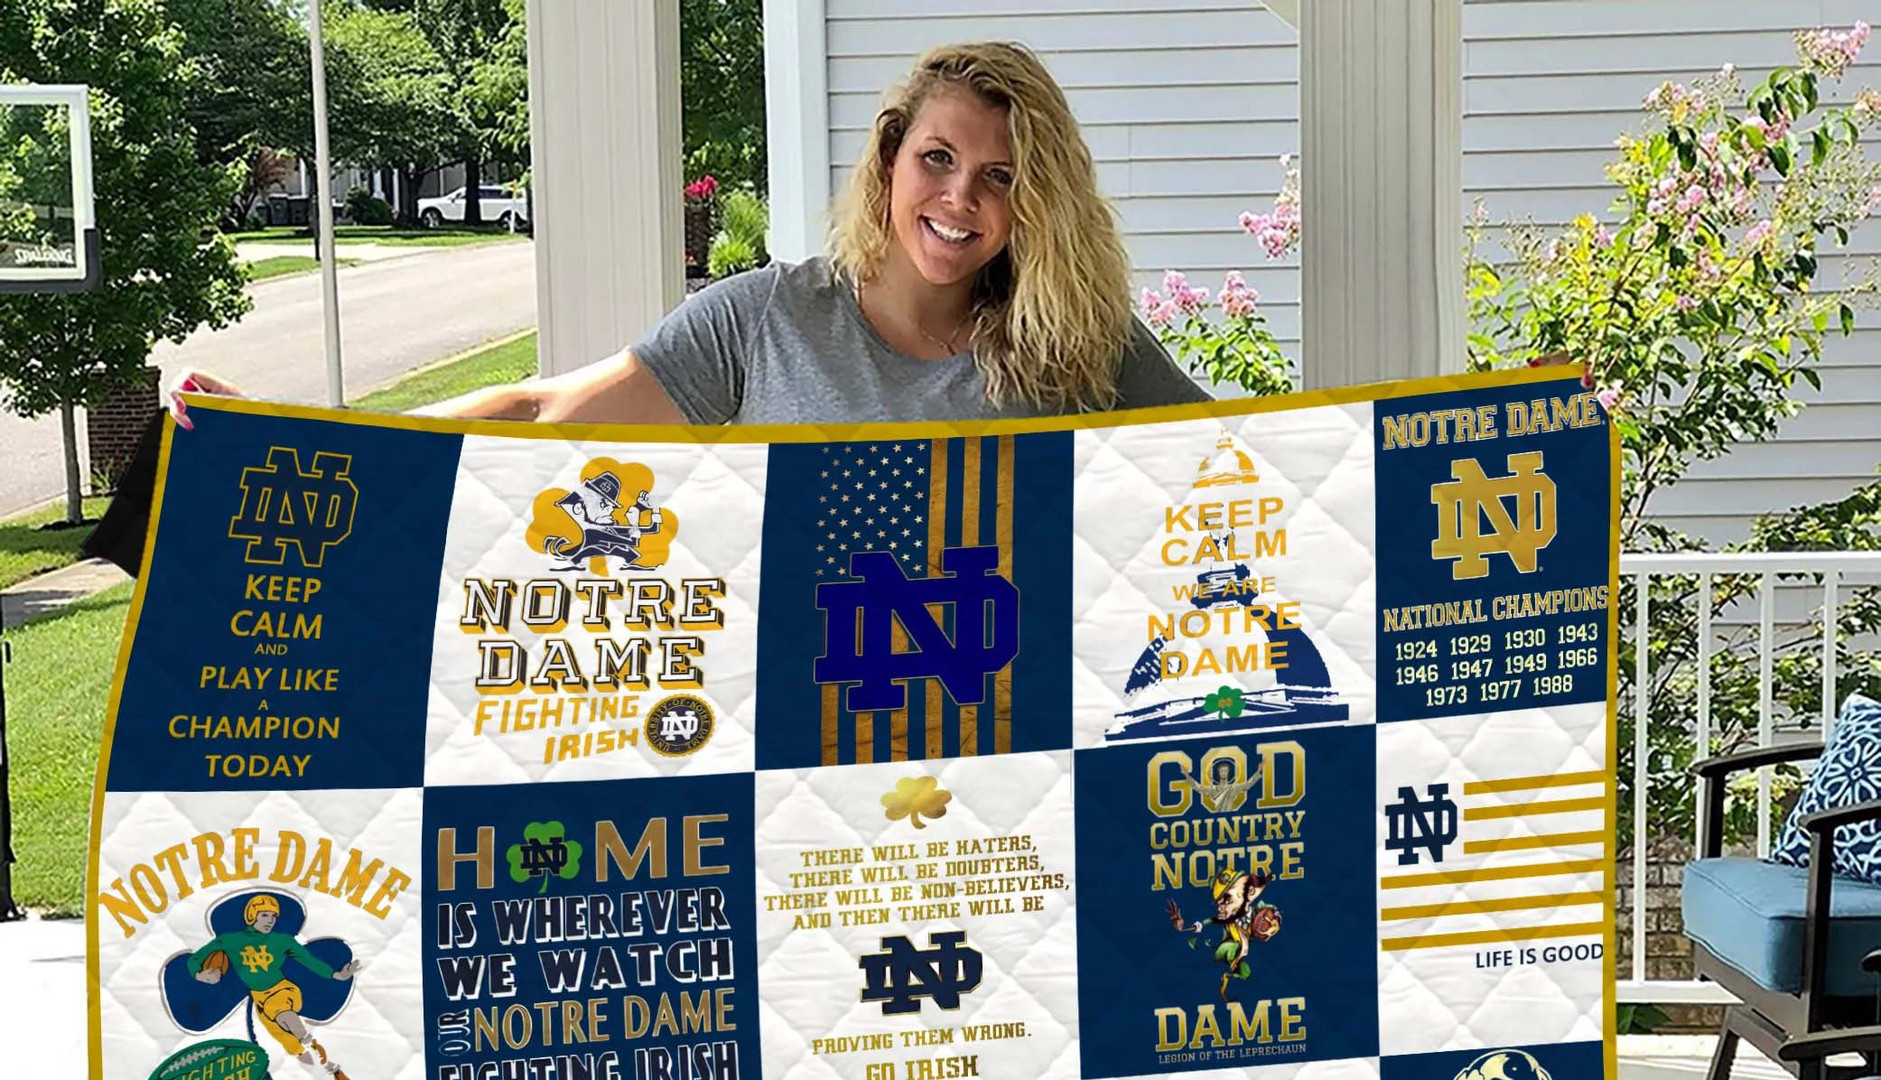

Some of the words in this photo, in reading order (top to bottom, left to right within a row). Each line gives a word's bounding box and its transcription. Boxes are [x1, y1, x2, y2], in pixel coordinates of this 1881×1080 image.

[14, 247, 74, 264] SPALDING
[1382, 404, 1498, 450] NOTRE
[1165, 497, 1284, 533] KEEP
[1161, 529, 1287, 567] CALM
[245, 574, 322, 603] KEEP
[460, 577, 727, 634] NOTRE
[1172, 583, 1213, 601] WE
[1223, 576, 1276, 597] ARE
[230, 610, 323, 639] CALM
[1147, 601, 1302, 642] NOTRE
[1383, 599, 1488, 632] NATIONAL
[1493, 585, 1610, 621] CHAMPIONS
[254, 643, 288, 656] AND
[1160, 641, 1290, 680] DAME
[1395, 640, 1438, 661] 1924
[1450, 634, 1491, 655] 1929
[1504, 628, 1546, 650] 1930
[1557, 622, 1598, 645] 1943
[200, 666, 273, 690] PLAY
[279, 668, 339, 691] LIKE
[475, 636, 705, 695] DAME
[1395, 664, 1438, 685] 1946
[1451, 659, 1492, 680] 1947
[1505, 653, 1547, 675] 1949
[1557, 647, 1598, 669] 1966
[257, 699, 268, 711] A
[1426, 685, 1468, 707] 1973
[1480, 680, 1521, 702] 1977
[1533, 674, 1573, 697] 1988
[168, 715, 340, 739] CHAMPION
[473, 695, 639, 737] FIGHTING
[544, 727, 638, 765] IRISH
[205, 754, 311, 778] TODAY
[1147, 740, 1305, 817] GOD
[1150, 810, 1305, 850] COUNTRY
[800, 847, 864, 867] THERE
[871, 843, 919, 864] WILL
[926, 841, 949, 857] BE
[956, 835, 1037, 855] HATERS,
[1151, 841, 1305, 891] NOTRE
[99, 827, 260, 939] NOTRE
[268, 830, 412, 921] DAME
[790, 869, 852, 888] THERE
[861, 865, 908, 885] WILL
[916, 862, 938, 879] BE
[946, 855, 1045, 877] DOUBTERS,
[764, 893, 828, 912] THERE
[835, 888, 883, 907] WILL
[891, 885, 913, 902] BE
[921, 874, 1070, 900] NON-BELIEVERS,
[437, 902, 477, 949] IS
[492, 886, 732, 945] WHEREVER
[793, 913, 831, 930] AND
[839, 908, 890, 927] THEN
[898, 902, 961, 922] THERE
[968, 898, 1015, 916] WILL
[1023, 896, 1044, 912] BE
[436, 953, 517, 1001] WE
[538, 937, 734, 993] WATCH
[1476, 950, 1513, 969] LIFE
[1520, 947, 1537, 966] IS
[1542, 943, 1604, 963] GOOD
[474, 997, 610, 1052] NOTRE
[623, 987, 737, 1040] DAME
[811, 1033, 893, 1055] PROVING
[900, 1028, 954, 1048] THEM
[961, 1022, 1032, 1043] WRONG.
[1155, 997, 1306, 1052] DAME
[1158, 1052, 1196, 1064] LEGION
[1199, 1049, 1212, 1061] OF
[1215, 1047, 1236, 1059] THE
[1239, 1043, 1307, 1058] LEPRECHAUN
